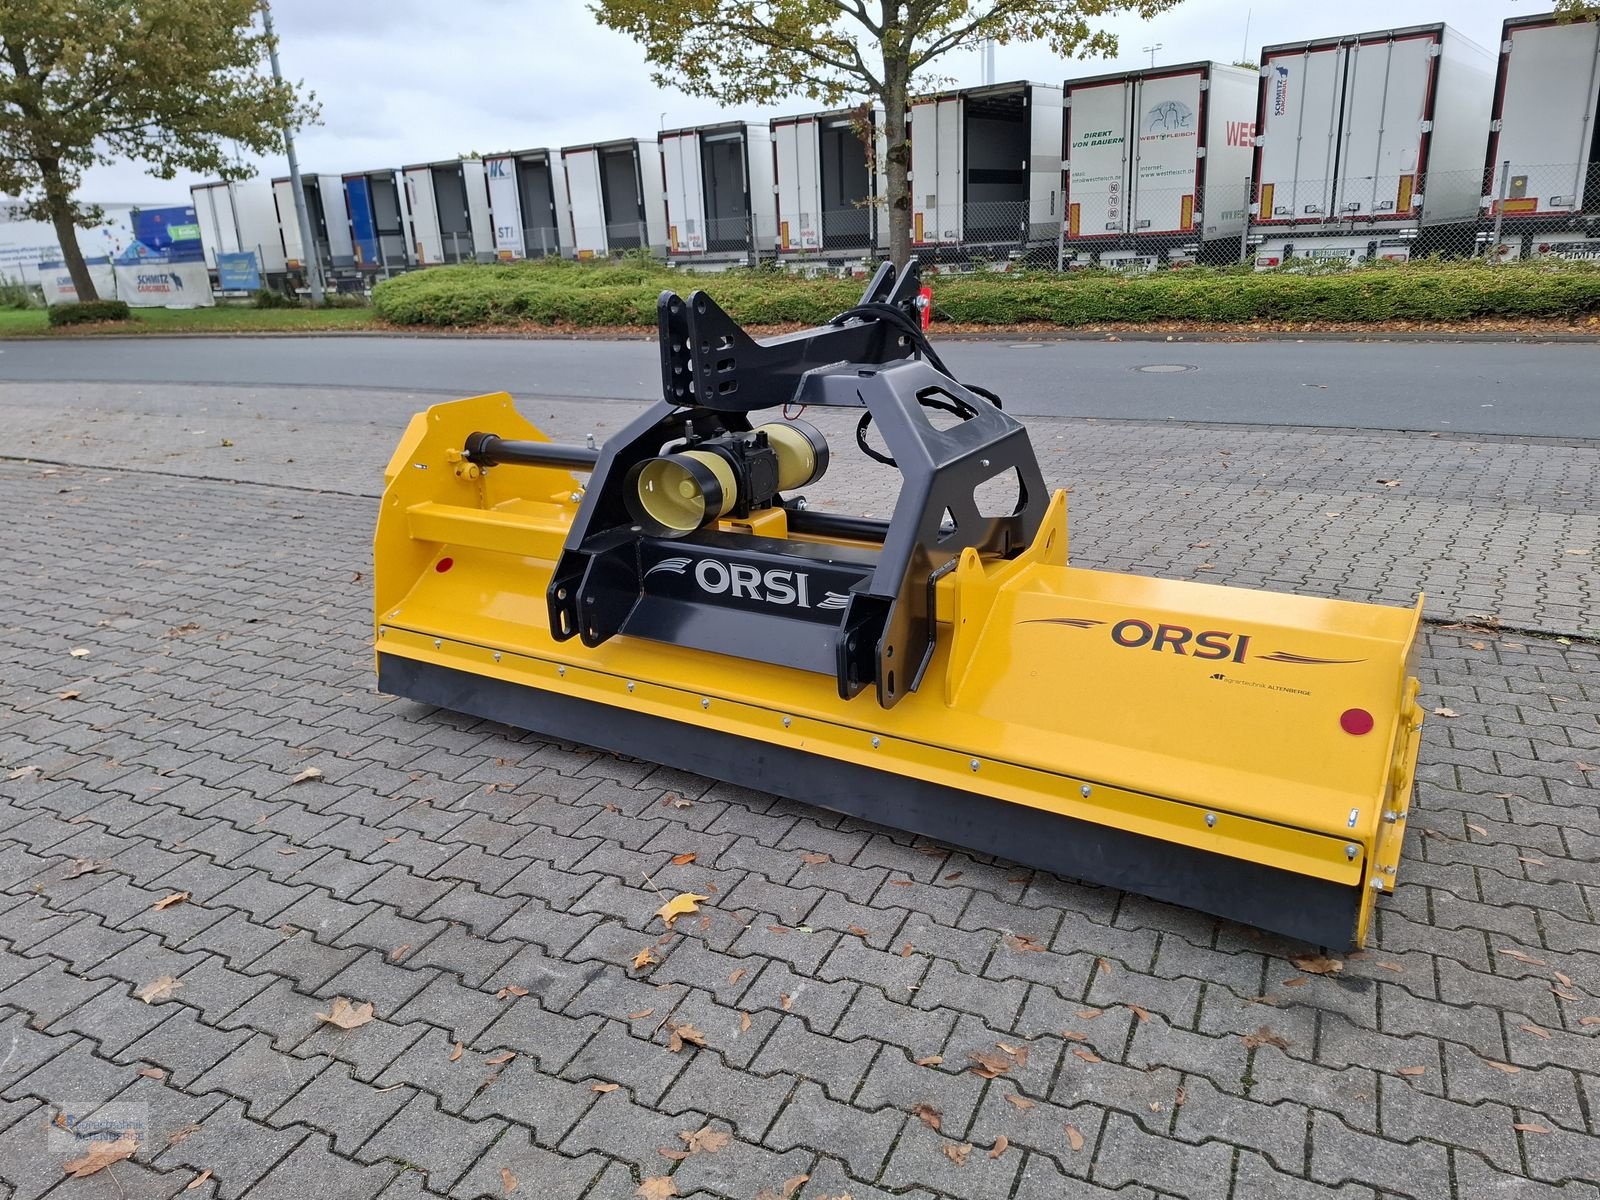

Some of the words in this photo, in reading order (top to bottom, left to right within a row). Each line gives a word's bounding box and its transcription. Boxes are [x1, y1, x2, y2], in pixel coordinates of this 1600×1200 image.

[1091, 137, 1124, 146] BAUERN
[695, 558, 811, 608] ORSI
[1111, 618, 1252, 664] ORSI
[1267, 684, 1311, 696] ALTENBERGE
